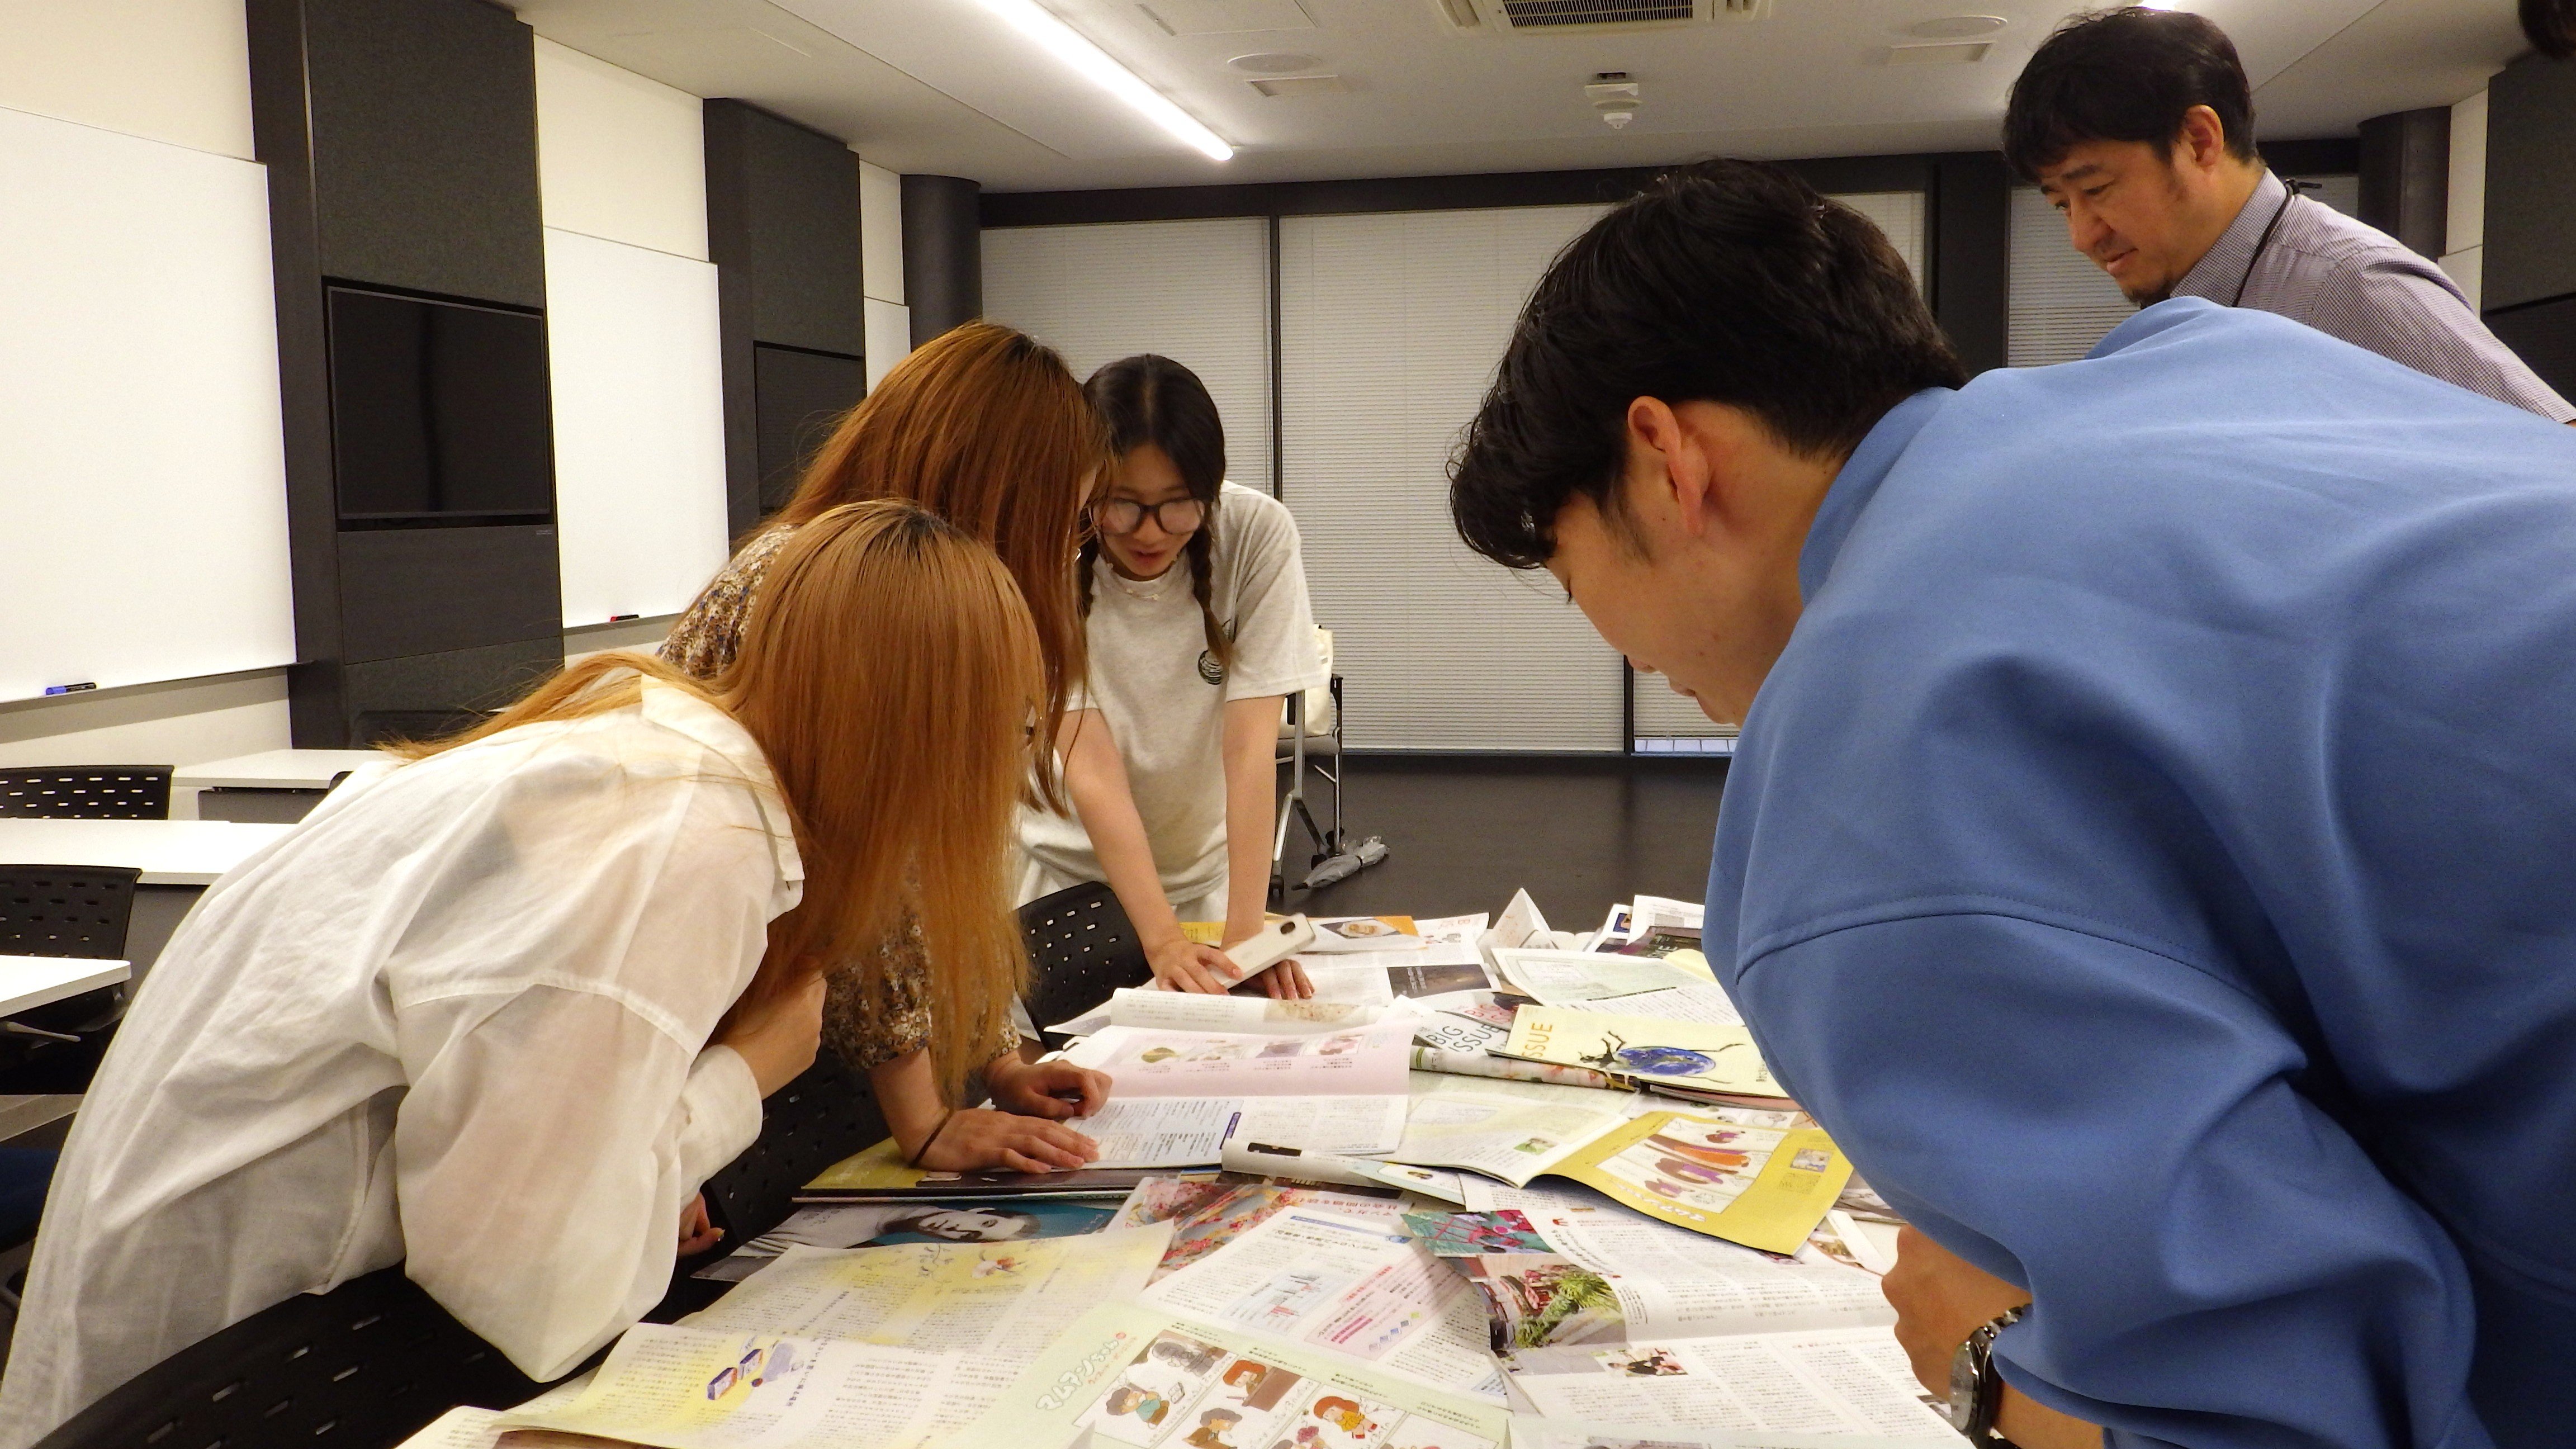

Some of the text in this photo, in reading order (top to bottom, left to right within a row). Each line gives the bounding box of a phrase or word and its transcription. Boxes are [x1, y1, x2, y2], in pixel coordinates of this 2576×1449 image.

[1426, 1026, 1464, 1045] BIG
[1448, 1023, 1500, 1052] ISSUE
[1521, 1022, 1553, 1058] SSUE
